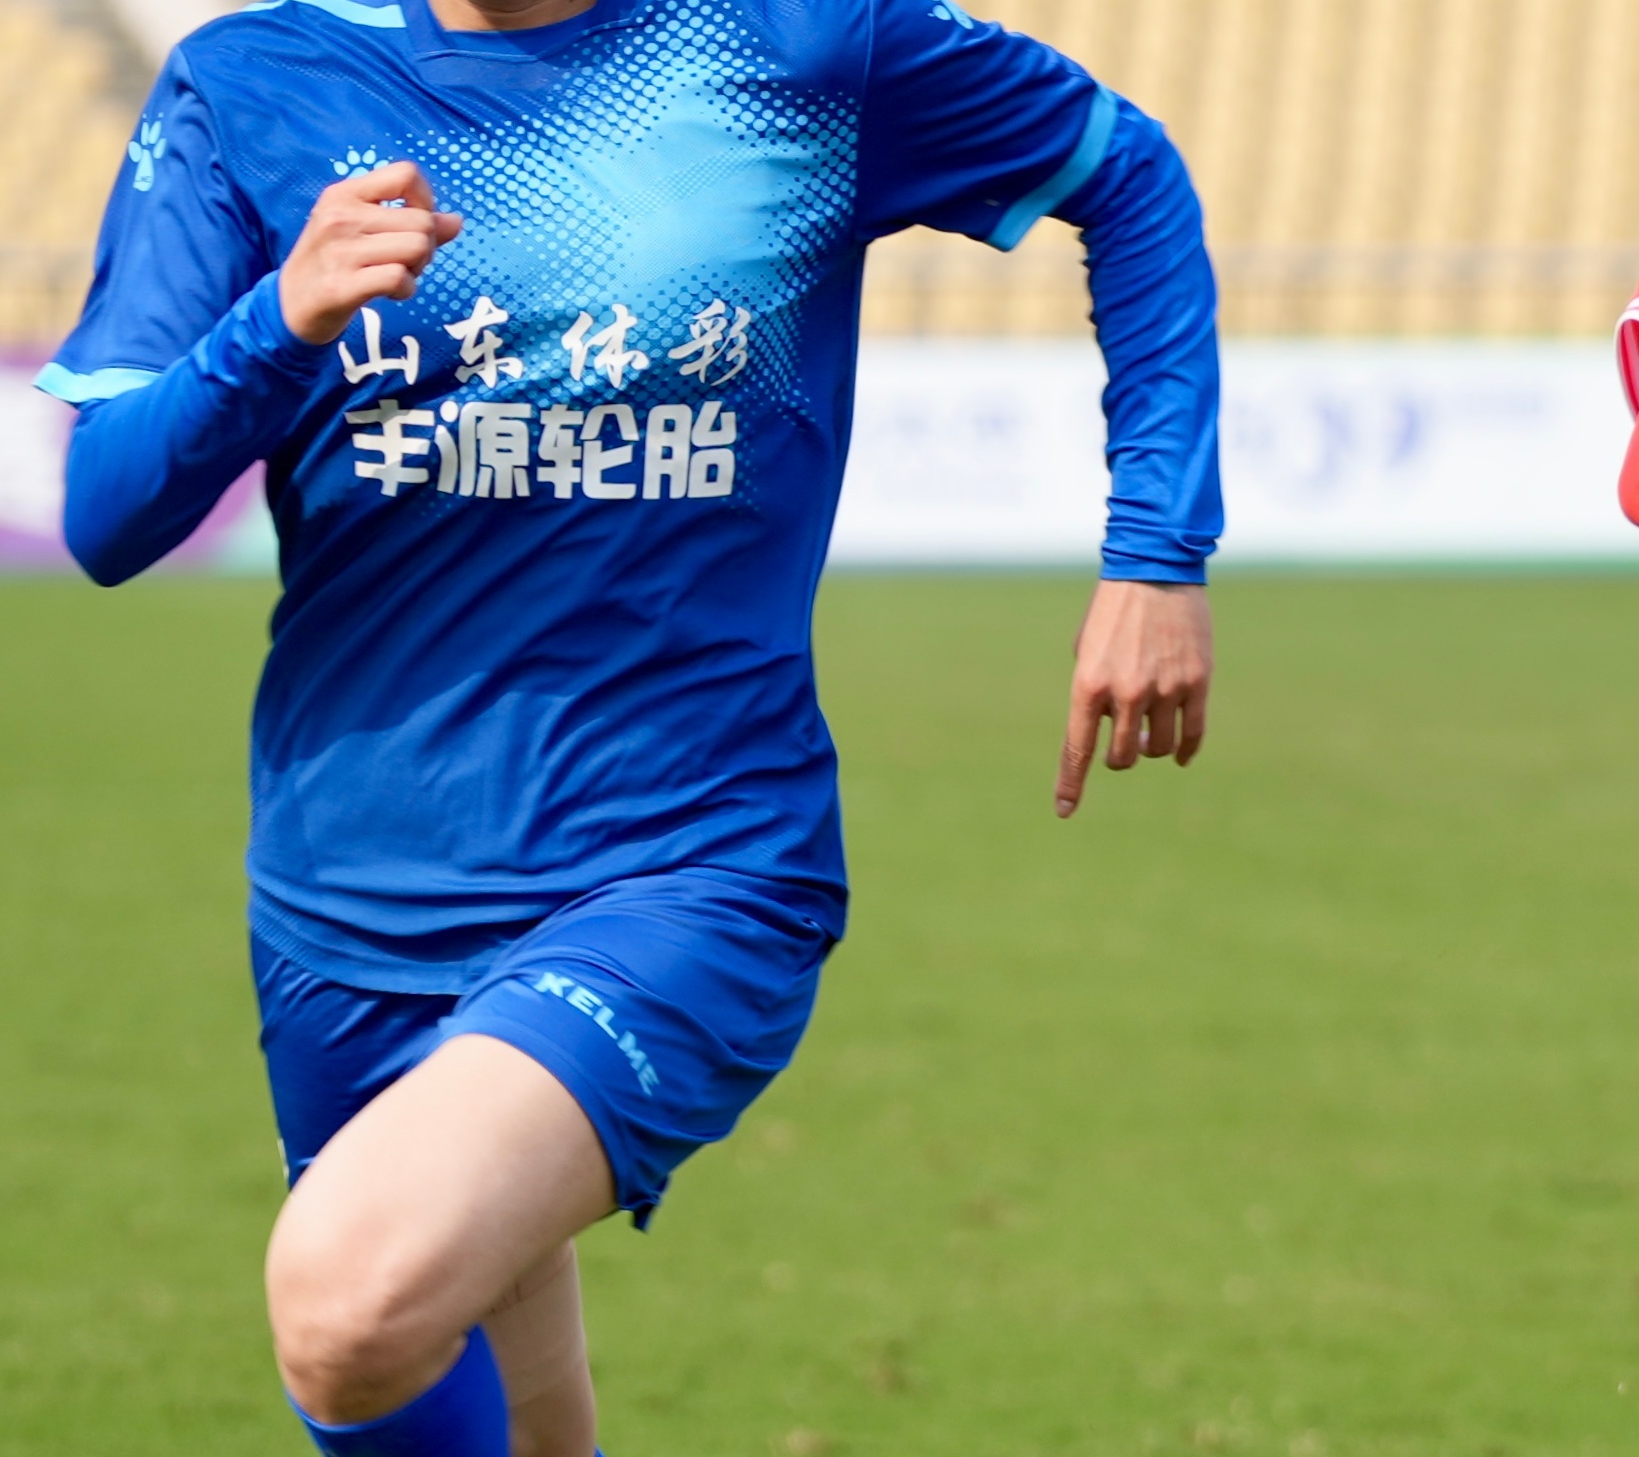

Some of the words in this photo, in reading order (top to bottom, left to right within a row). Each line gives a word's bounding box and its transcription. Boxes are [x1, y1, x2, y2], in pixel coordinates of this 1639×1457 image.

[337, 295, 752, 391] 山东体彩
[345, 399, 737, 501] 丰源轮胎
